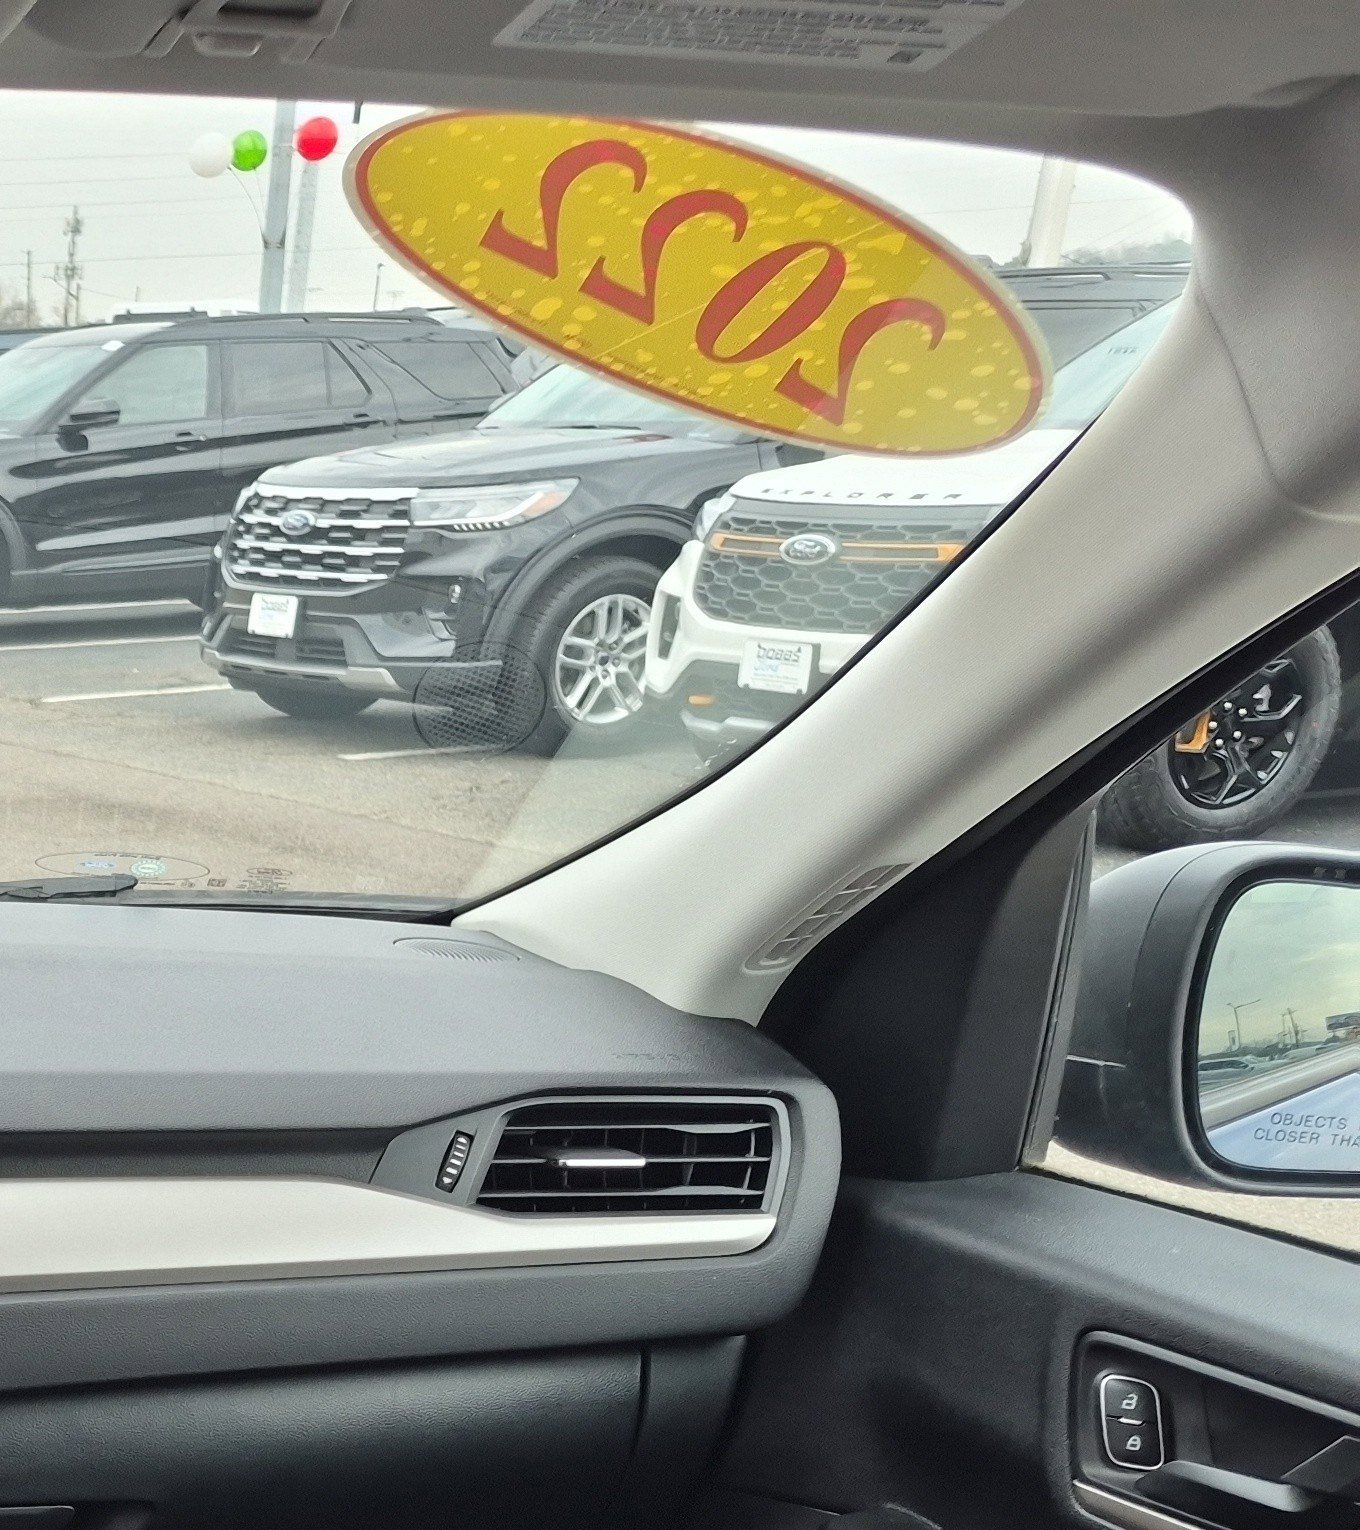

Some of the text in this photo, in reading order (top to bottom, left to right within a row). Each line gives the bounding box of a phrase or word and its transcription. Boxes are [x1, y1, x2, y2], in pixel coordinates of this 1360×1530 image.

[761, 488, 963, 500] EXPLORER
[1270, 1112, 1348, 1130] OBJECTS
[1253, 1127, 1360, 1147] CLOSER THA
